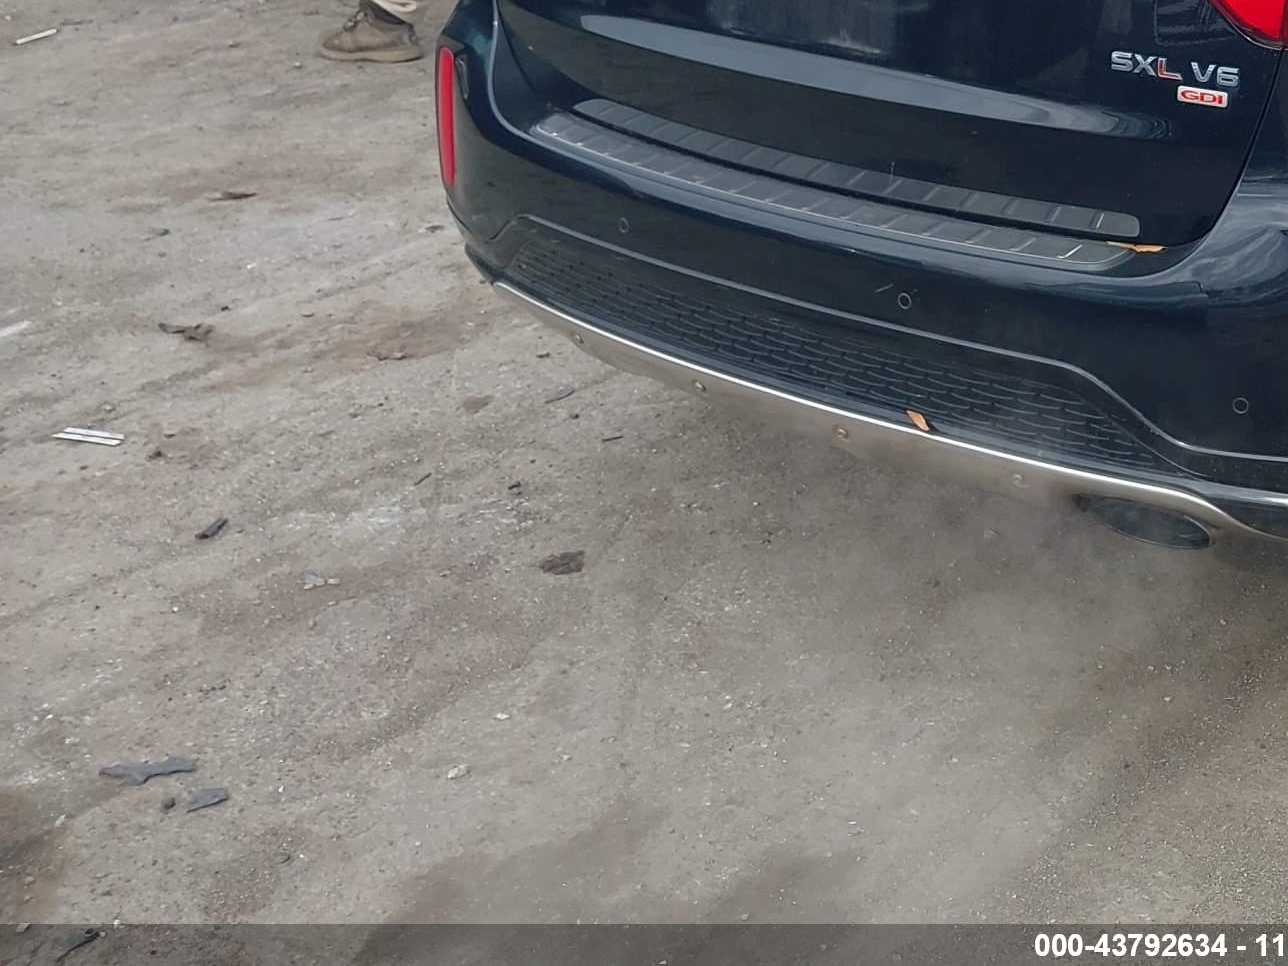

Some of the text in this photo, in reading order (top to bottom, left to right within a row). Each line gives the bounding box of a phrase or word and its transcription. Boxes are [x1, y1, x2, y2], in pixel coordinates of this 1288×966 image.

[1110, 50, 1240, 87] SXL V6
[1180, 89, 1224, 105] GDI
